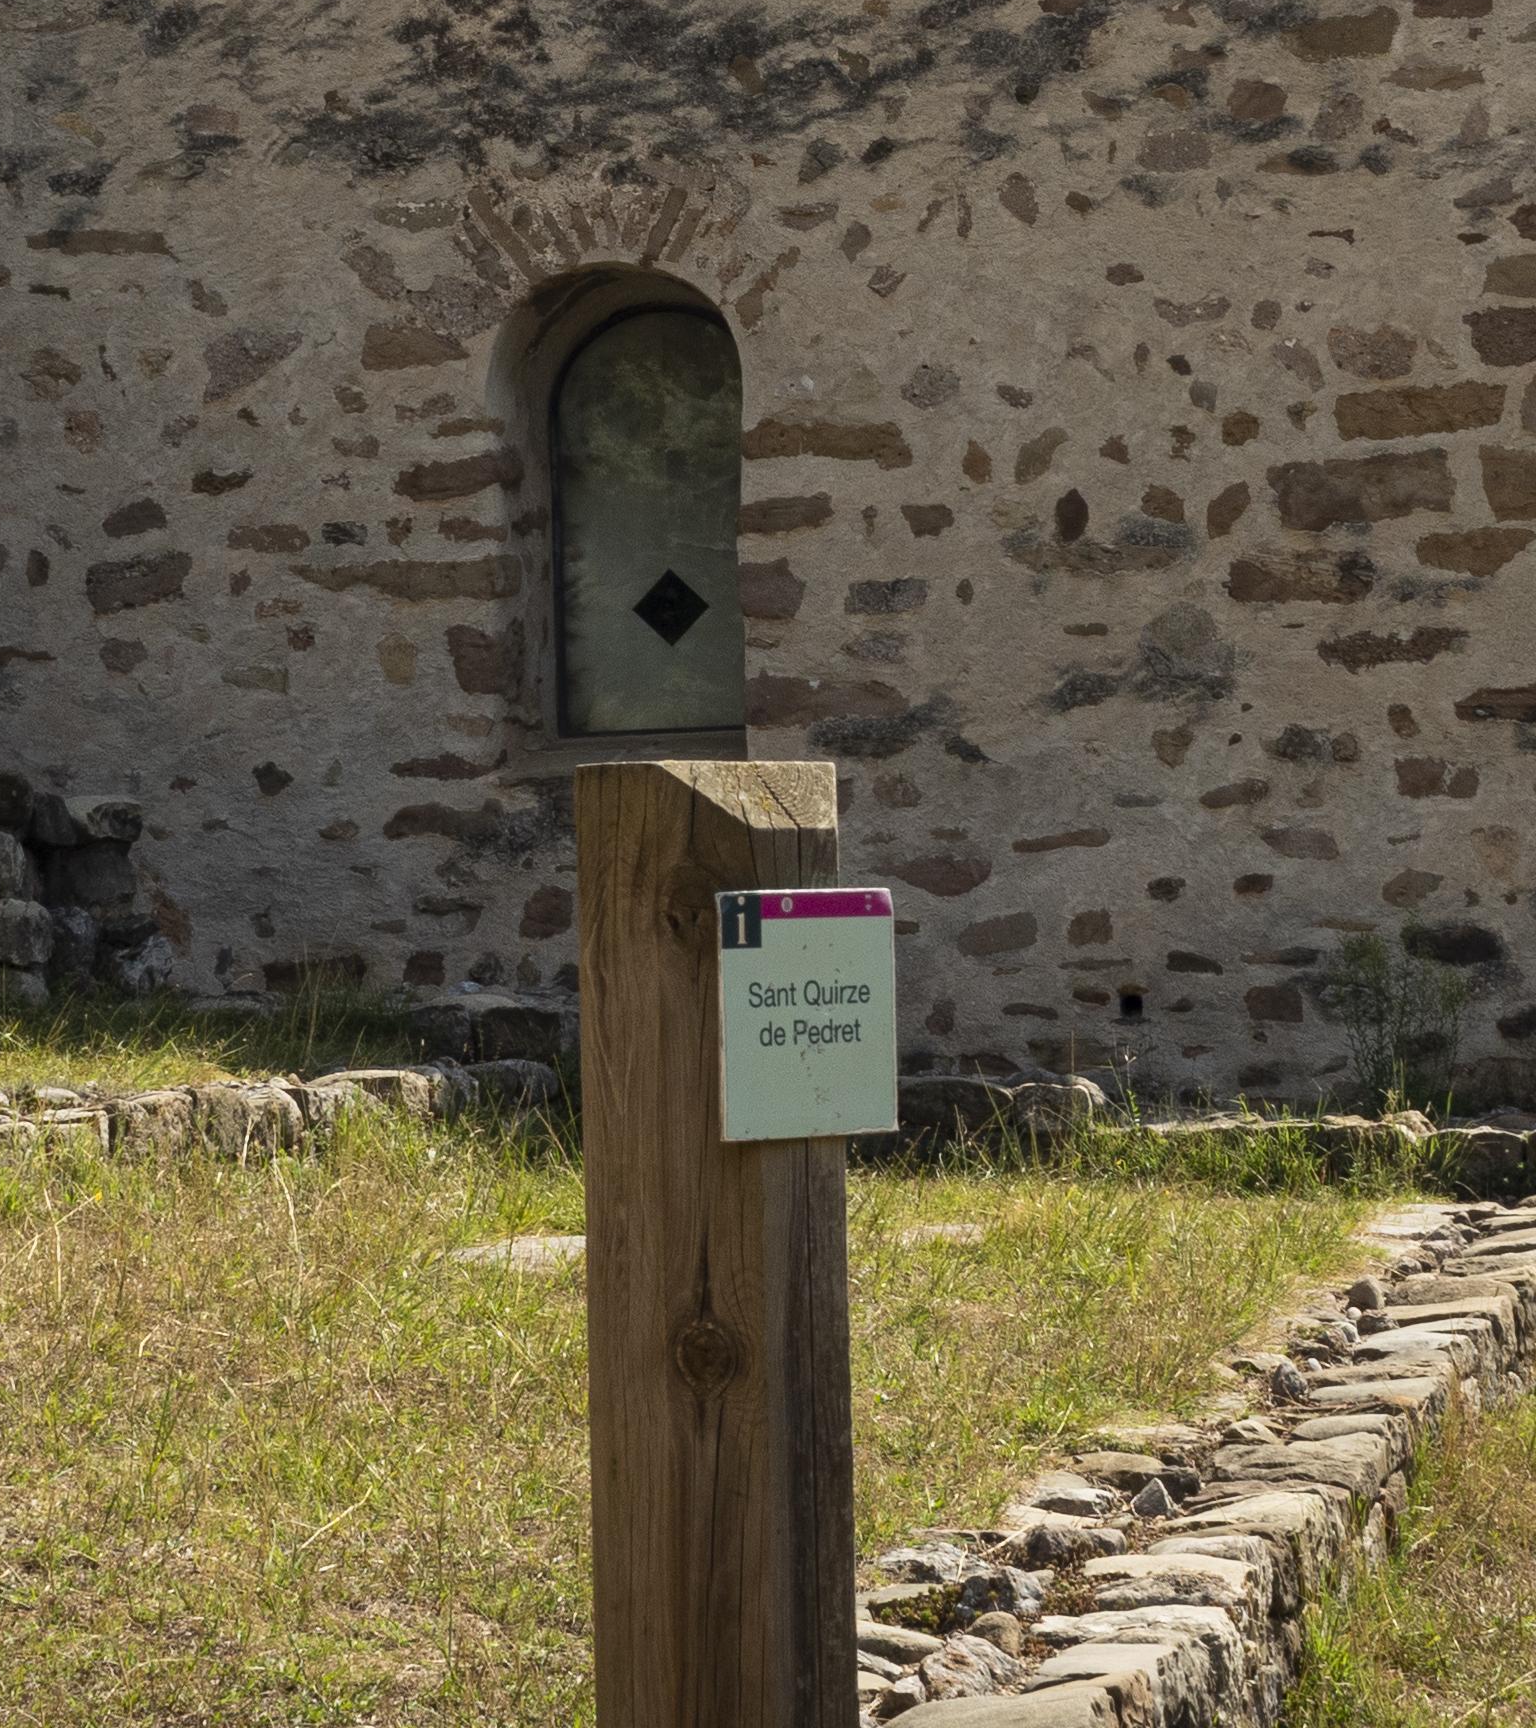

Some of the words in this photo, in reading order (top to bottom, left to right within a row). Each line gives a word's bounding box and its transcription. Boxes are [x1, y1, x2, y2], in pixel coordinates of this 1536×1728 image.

[748, 982, 797, 1008] Sant
[803, 979, 871, 1006] Quirze
[759, 1021, 786, 1046] de
[793, 1019, 862, 1045] Pedret
